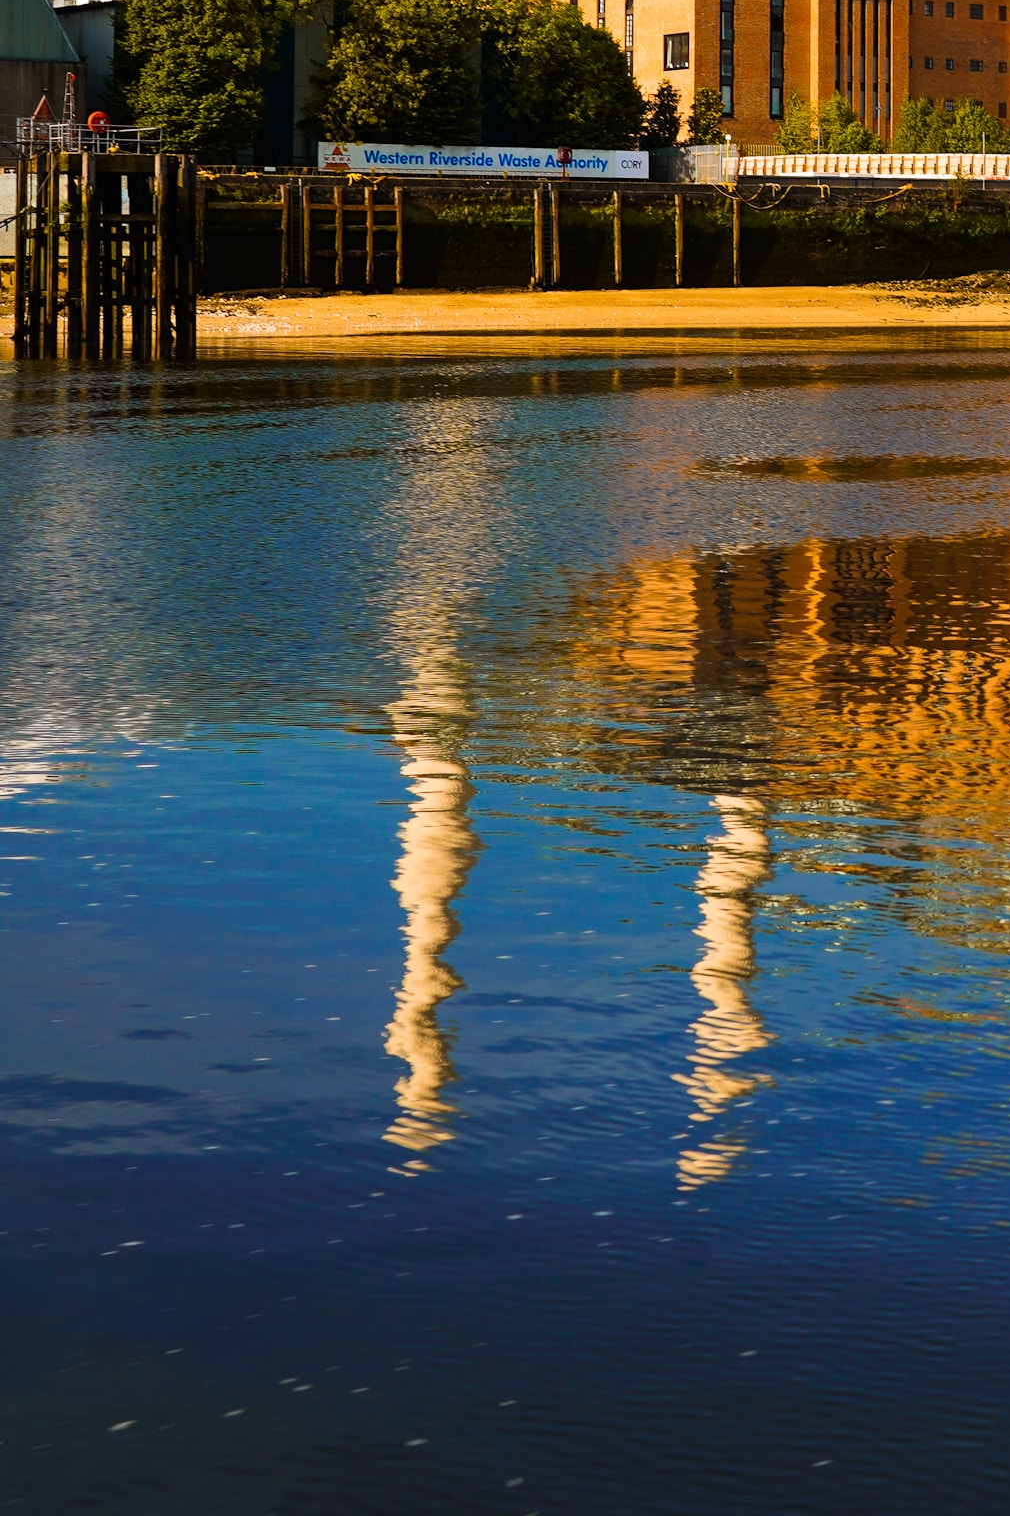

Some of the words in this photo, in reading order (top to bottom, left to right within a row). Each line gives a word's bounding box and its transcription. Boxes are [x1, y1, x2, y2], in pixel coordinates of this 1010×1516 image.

[364, 150, 424, 165] Western
[429, 151, 493, 166] Riverside
[498, 153, 541, 168] Waste
[621, 159, 642, 169] CORY
